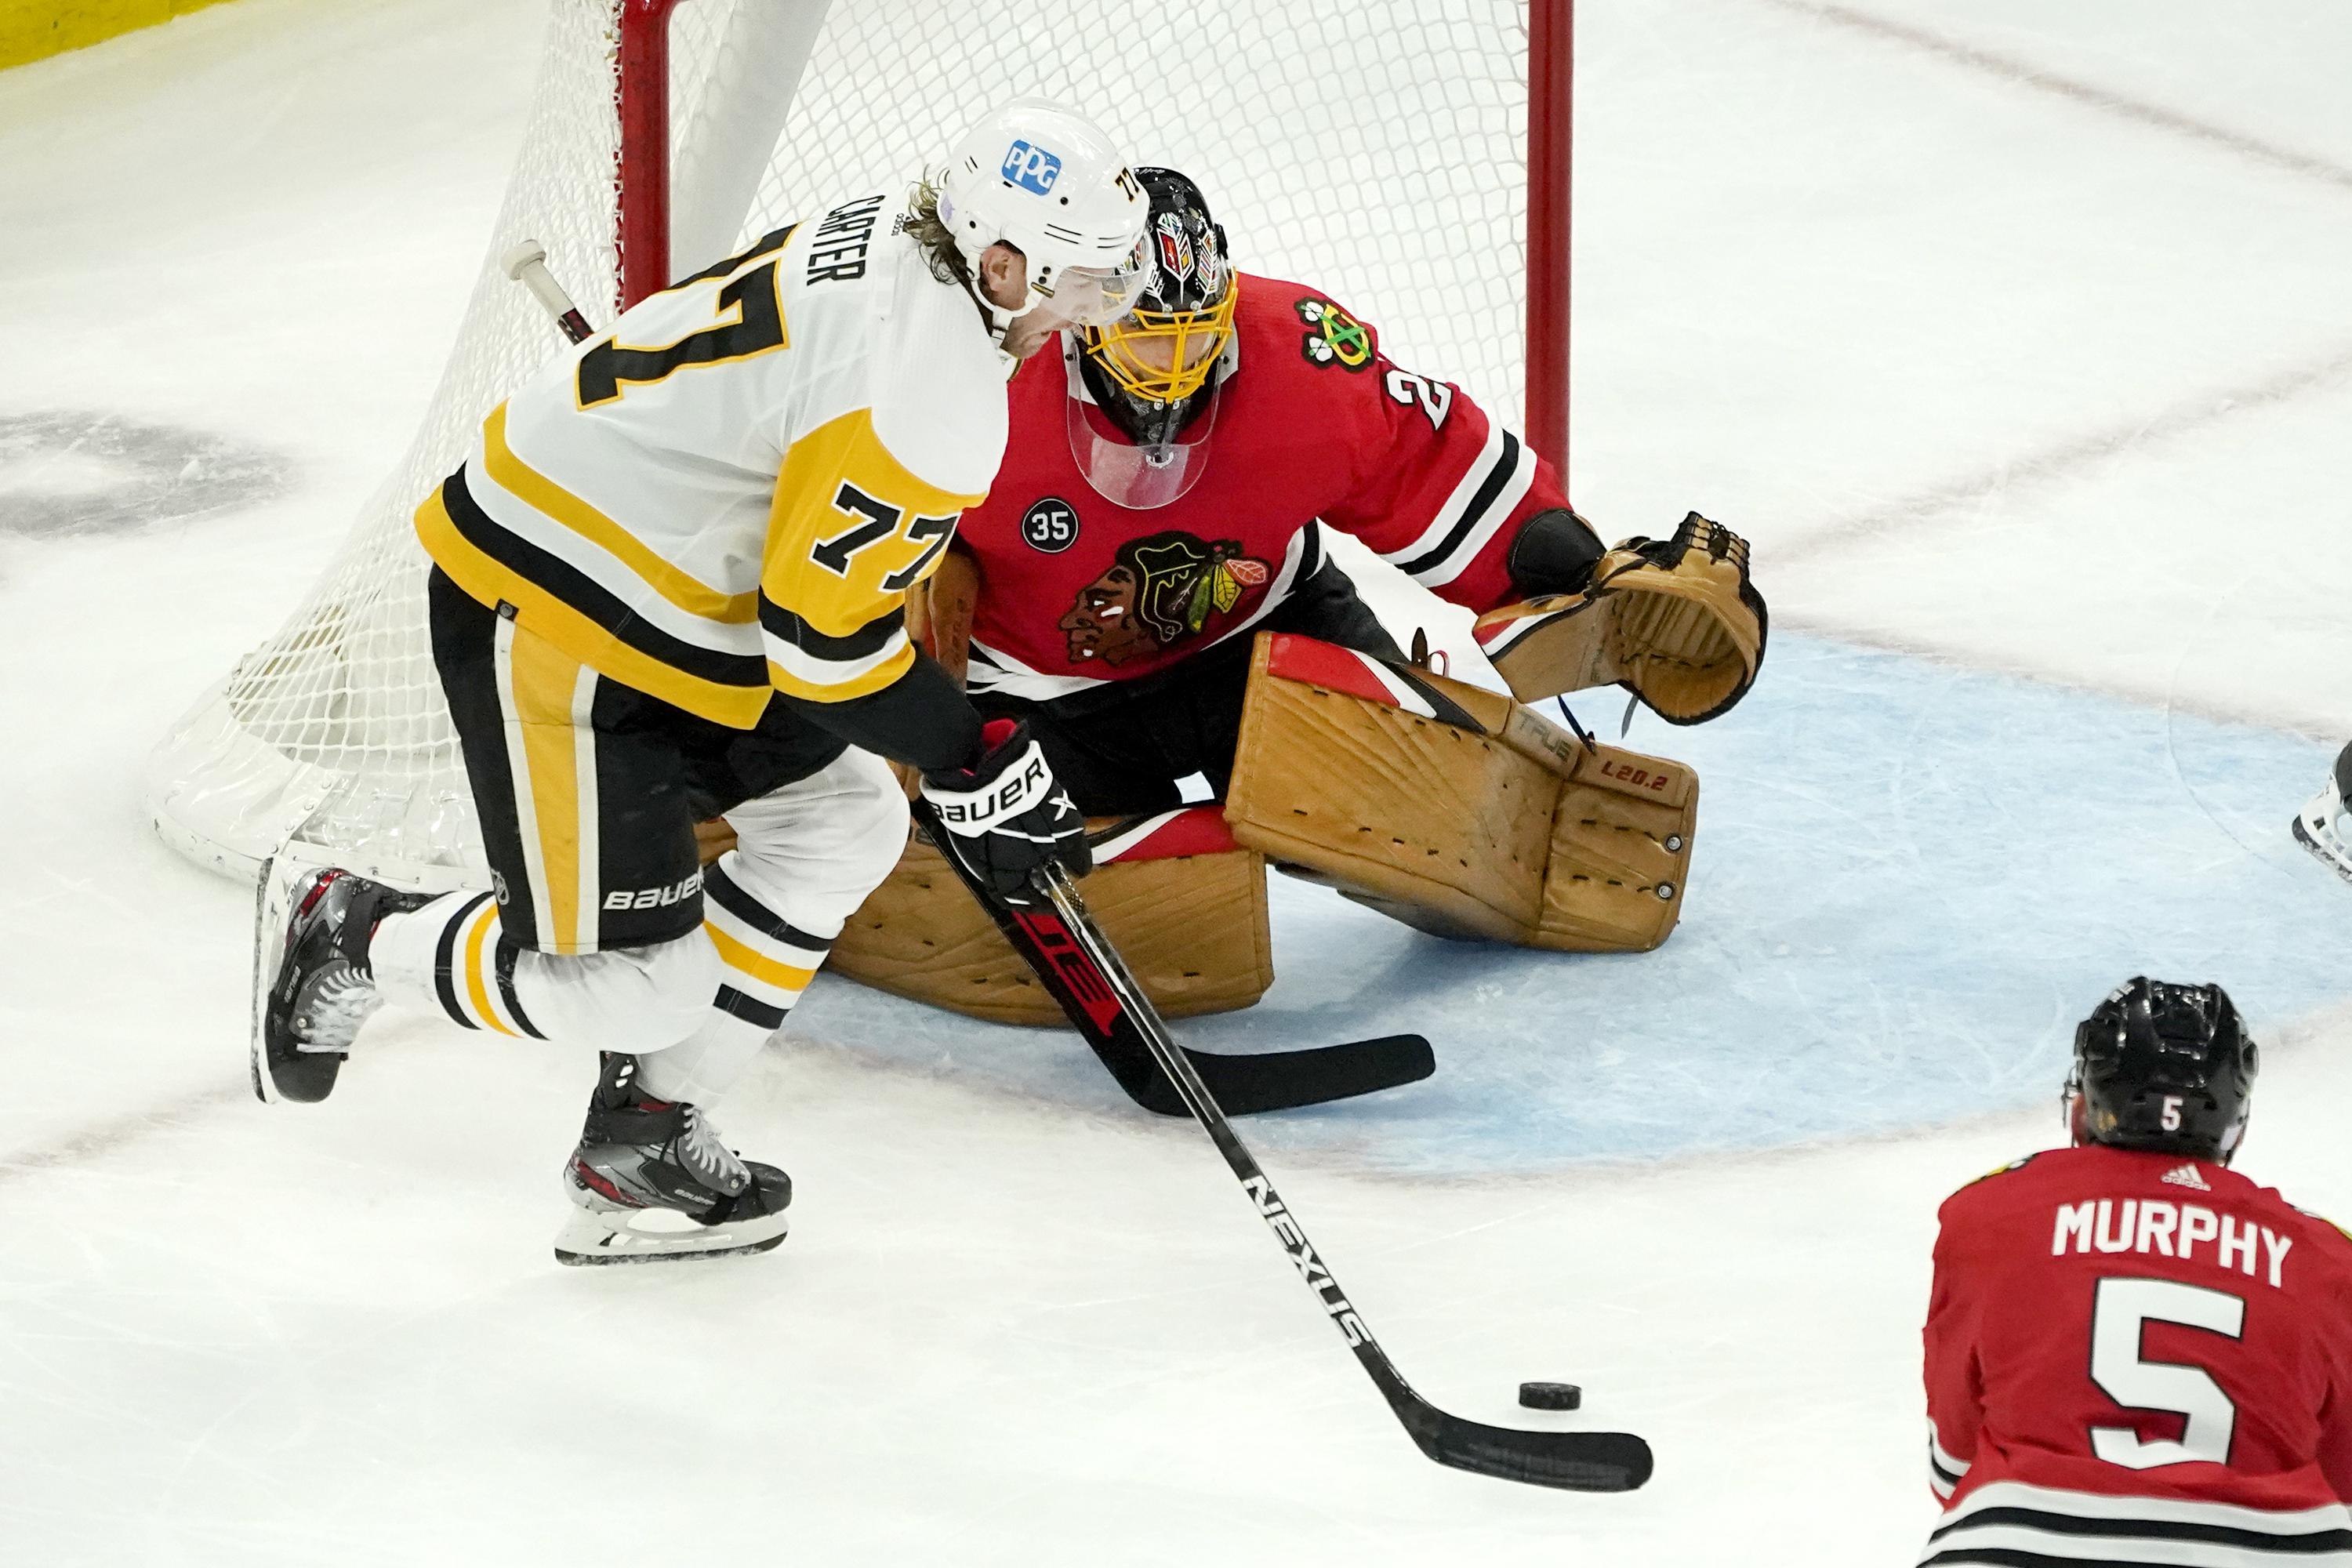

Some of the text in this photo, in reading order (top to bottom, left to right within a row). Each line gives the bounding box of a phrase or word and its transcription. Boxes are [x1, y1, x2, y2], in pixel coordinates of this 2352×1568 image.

[1005, 145, 1058, 190] PPG
[1114, 166, 1140, 203] 77
[806, 194, 886, 287] CARTER
[808, 477, 963, 594] 77
[1031, 510, 1069, 541] 35
[1601, 760, 1668, 792] L20.2
[2160, 1095, 2184, 1131] 5
[1241, 1174, 1374, 1348] NEXUS
[2051, 1198, 2293, 1289] MURPHY
[2088, 1276, 2248, 1471] 5
